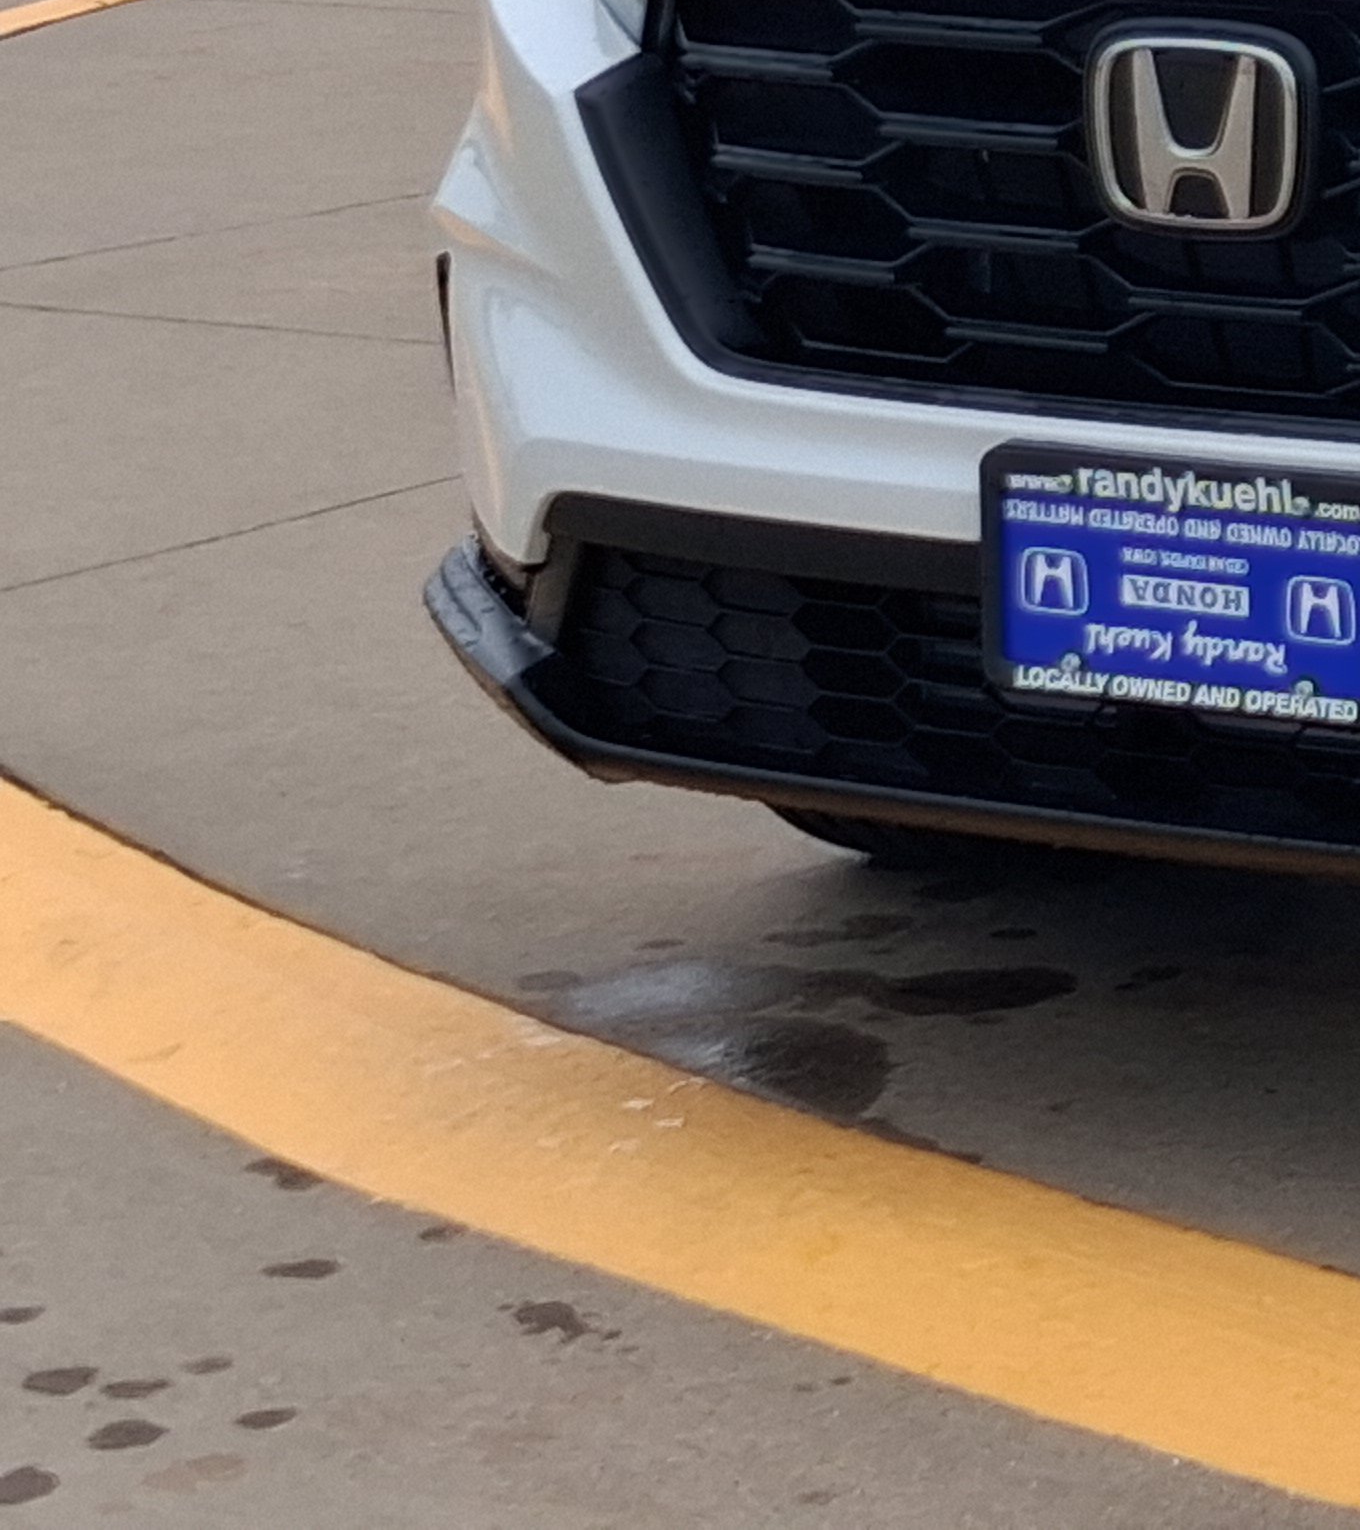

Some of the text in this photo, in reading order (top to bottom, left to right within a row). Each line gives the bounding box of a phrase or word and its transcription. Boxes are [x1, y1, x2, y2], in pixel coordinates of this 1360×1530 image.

[1088, 507, 1180, 536] OPERATED
[1184, 518, 1221, 540] AND
[1226, 523, 1292, 548] OWNED
[1127, 577, 1243, 613] HONDA
[1086, 619, 1287, 675] Randy Kuehl
[1012, 664, 1359, 722] LOCALLY OWNED AND OPERATED
